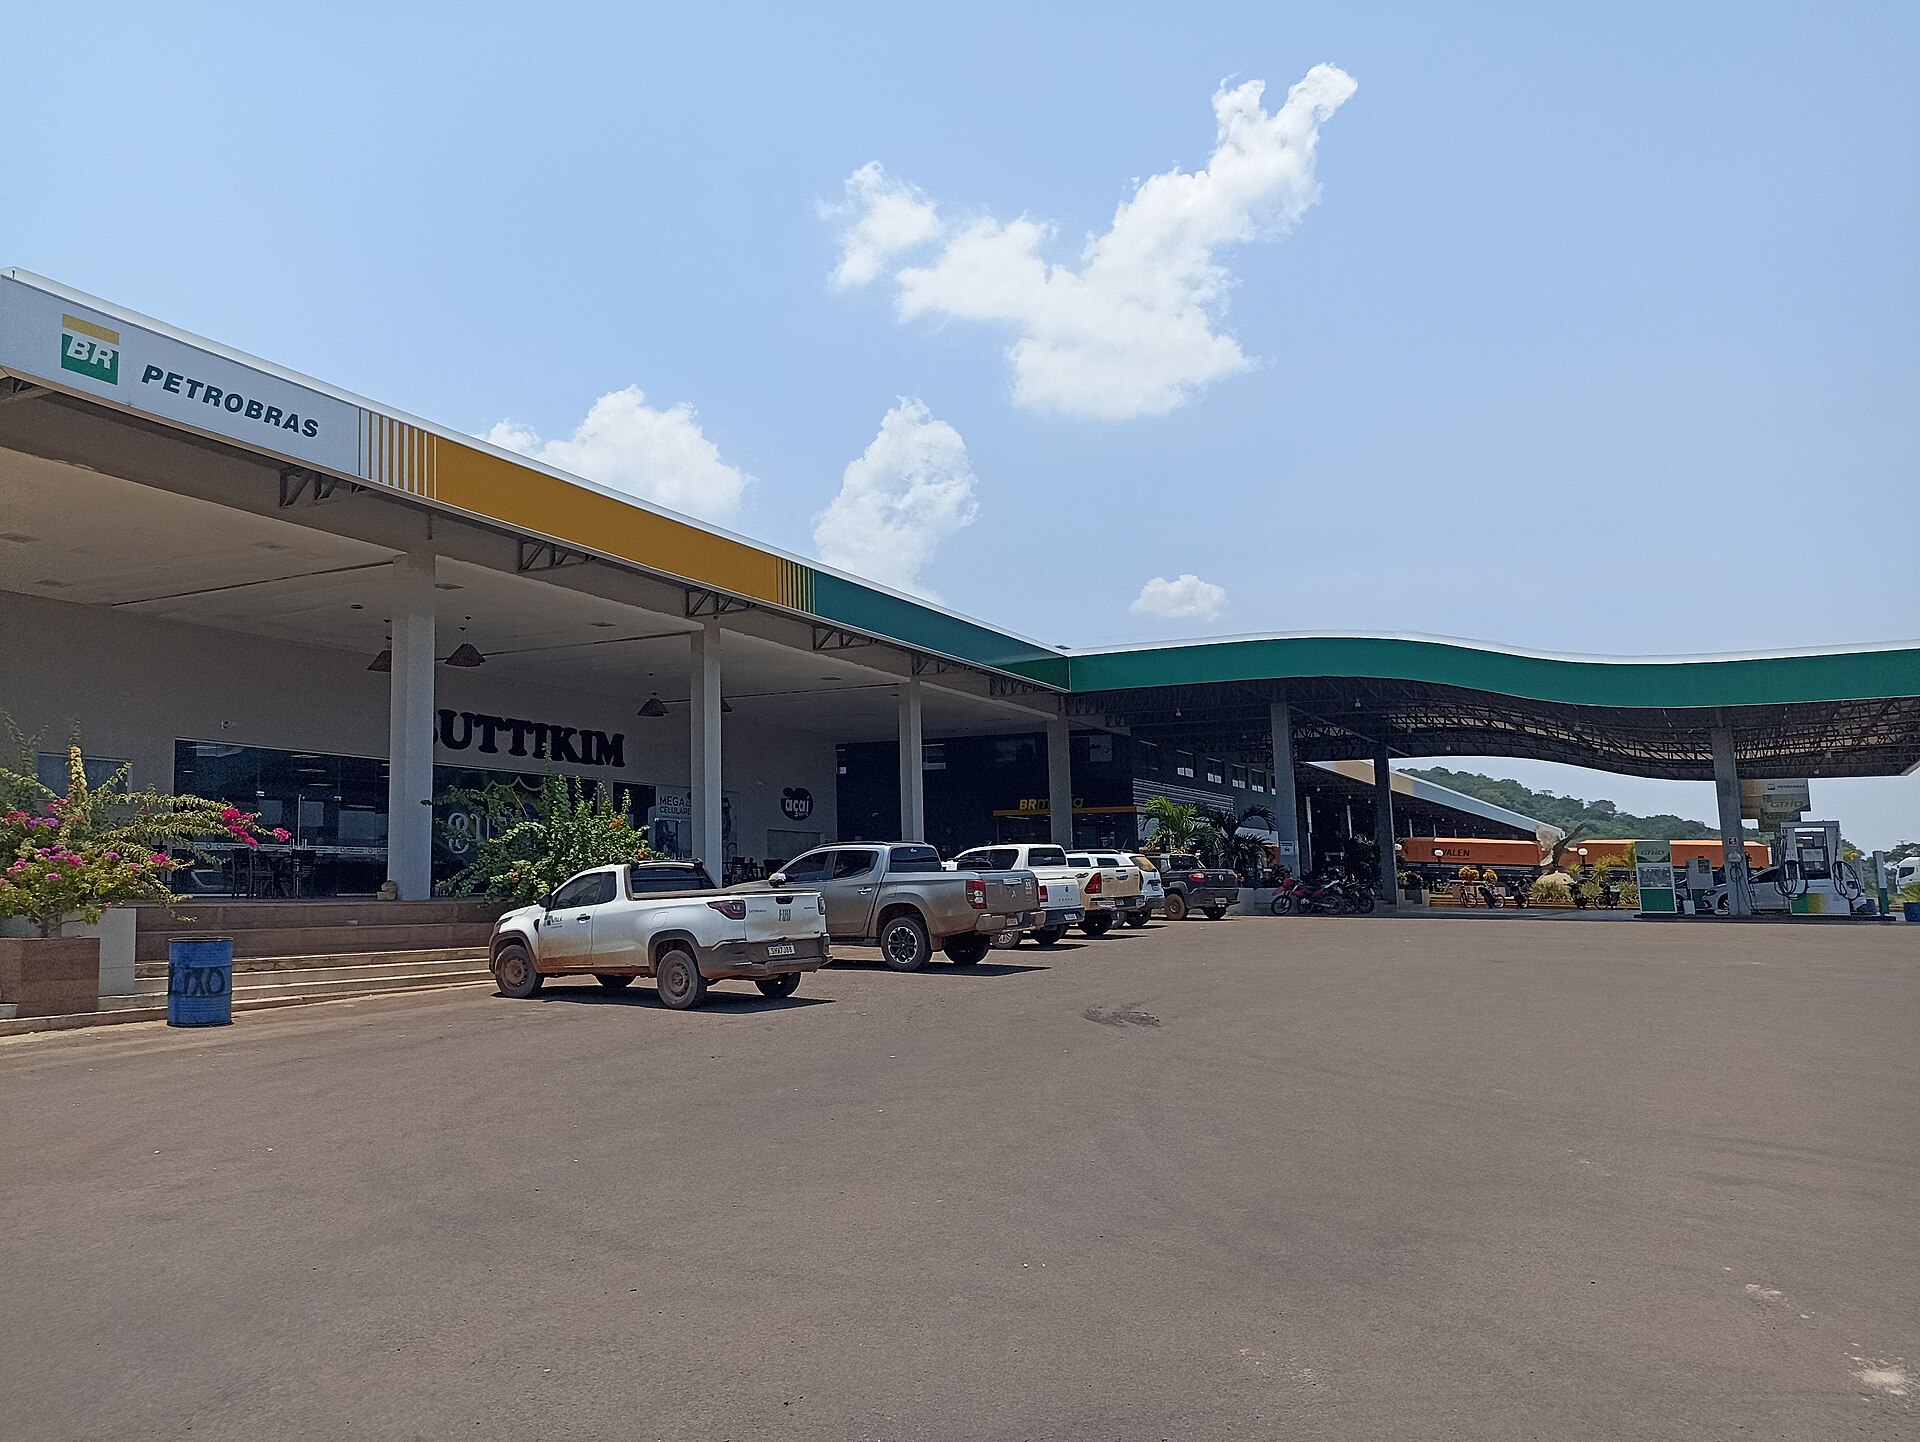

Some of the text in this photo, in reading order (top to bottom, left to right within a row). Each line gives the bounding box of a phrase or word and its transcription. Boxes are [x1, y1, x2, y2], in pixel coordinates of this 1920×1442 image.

[66, 337, 114, 369] BR
[141, 364, 319, 438] PETROBRAS
[434, 708, 626, 768] UTTIKIM
[660, 795, 685, 807] MEGA
[660, 806, 691, 815] CELULARE
[1020, 798, 1084, 810] BRma
